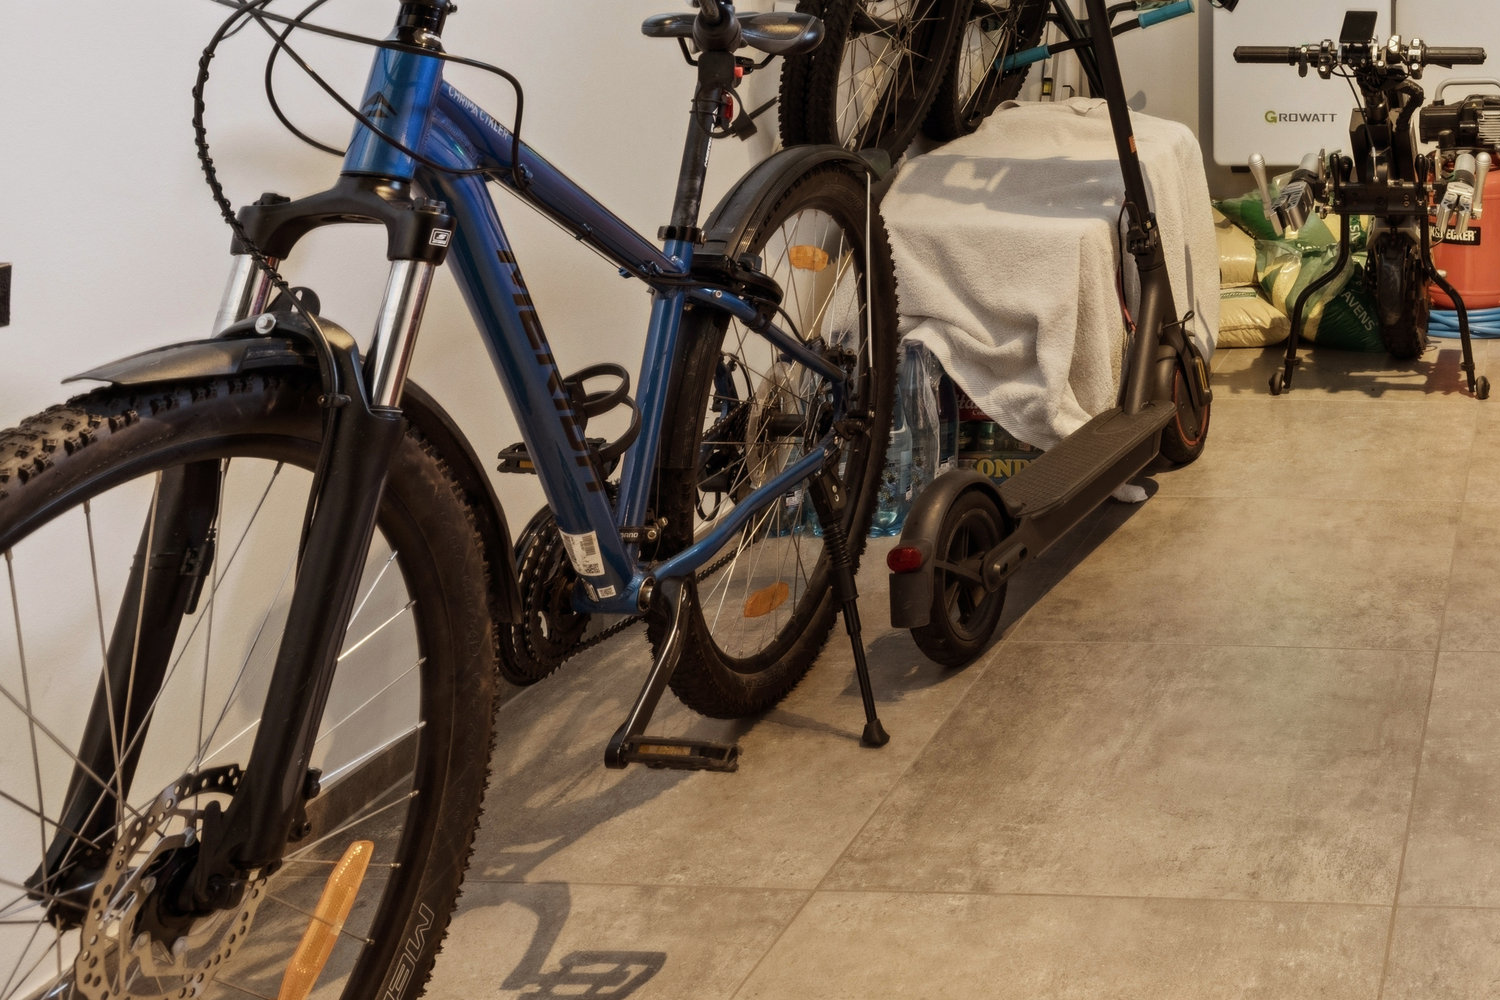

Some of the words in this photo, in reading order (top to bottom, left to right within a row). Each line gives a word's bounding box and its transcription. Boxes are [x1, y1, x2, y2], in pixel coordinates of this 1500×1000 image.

[1264, 110, 1338, 124] GROWATT
[1341, 290, 1377, 331] AVENS
[975, 458, 1035, 479] OND
[383, 902, 435, 1000] ME
